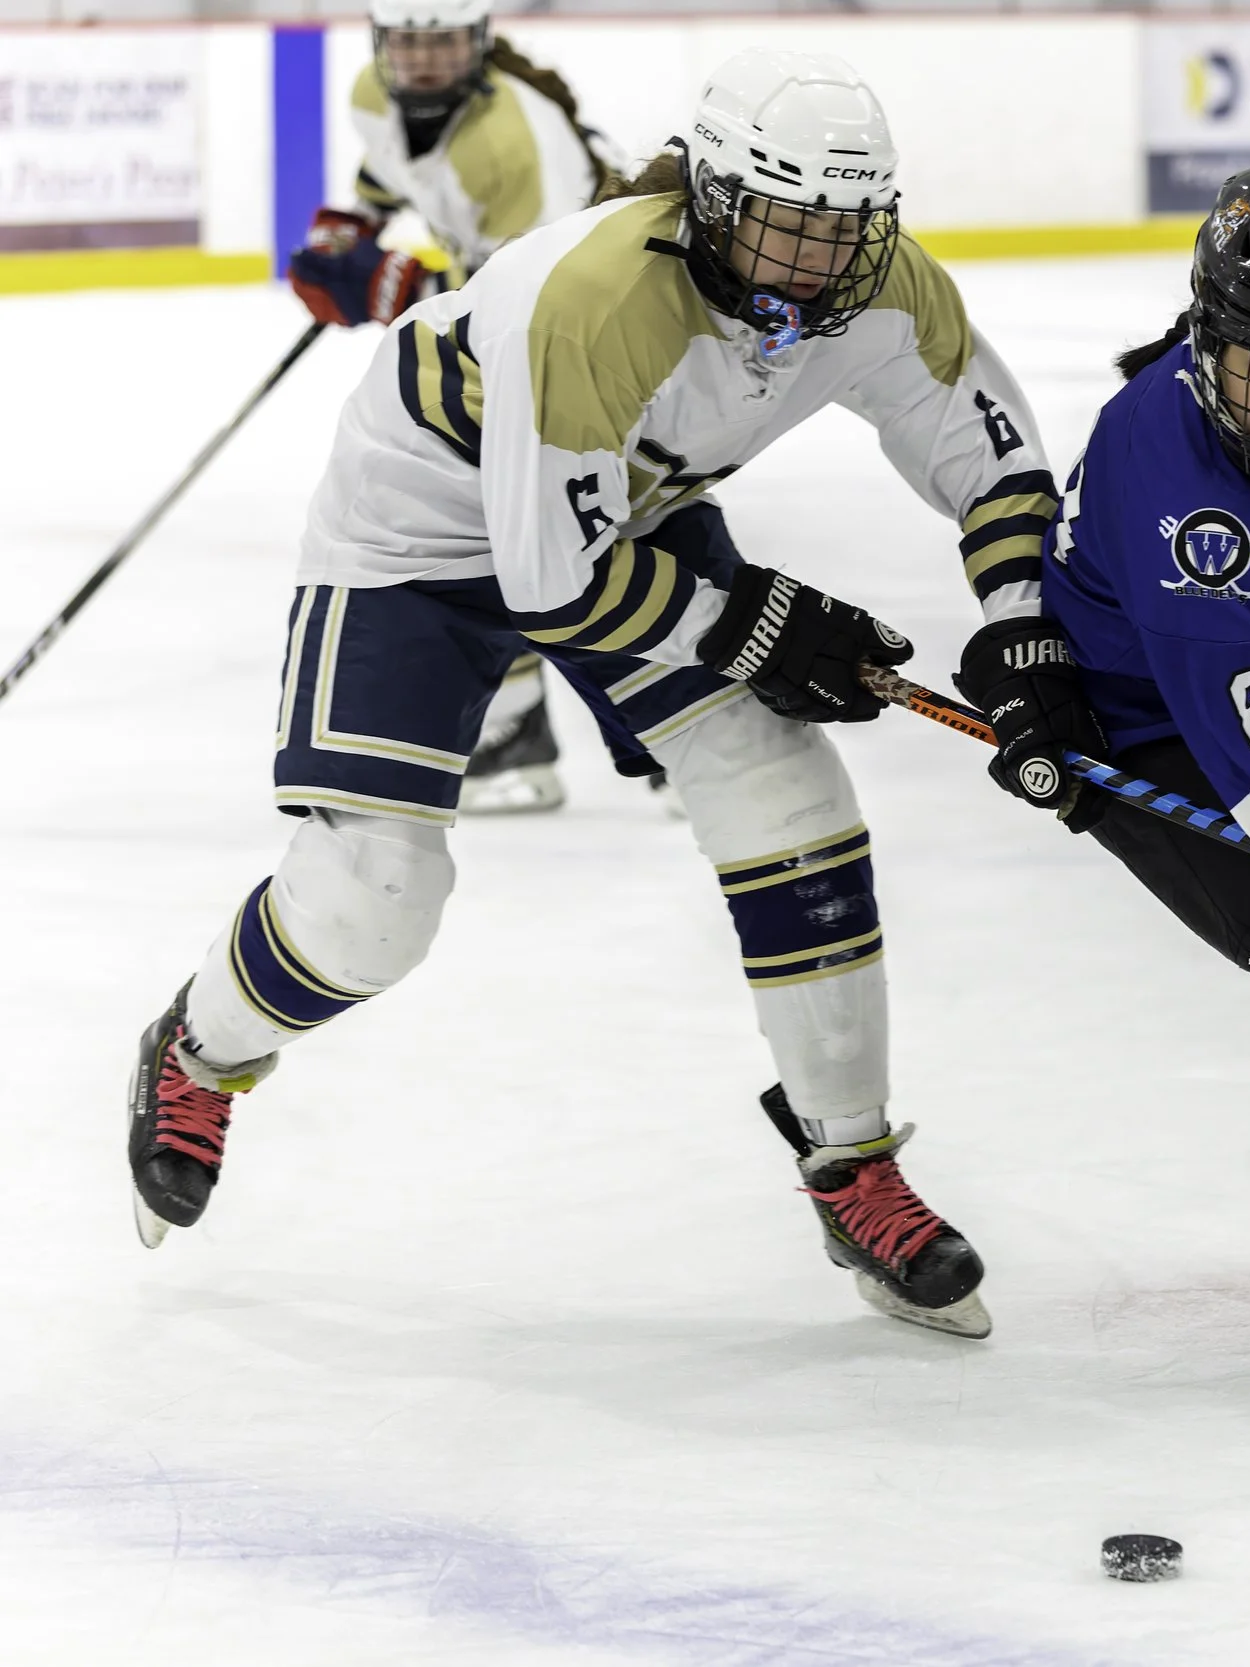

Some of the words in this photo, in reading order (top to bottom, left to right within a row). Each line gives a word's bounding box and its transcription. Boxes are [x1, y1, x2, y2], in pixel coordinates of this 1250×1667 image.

[694, 123, 723, 148] CCM
[822, 166, 877, 181] CCM
[706, 186, 732, 205] CCM
[974, 389, 1024, 461] 6
[1185, 530, 1241, 576] W
[1174, 586, 1208, 598] BLUE
[1209, 588, 1248, 604] DEVS
[719, 574, 800, 682] WARRIOR
[1003, 638, 1078, 670] WAR
[808, 680, 845, 706] ALPHA
[910, 701, 988, 741] RIOR
